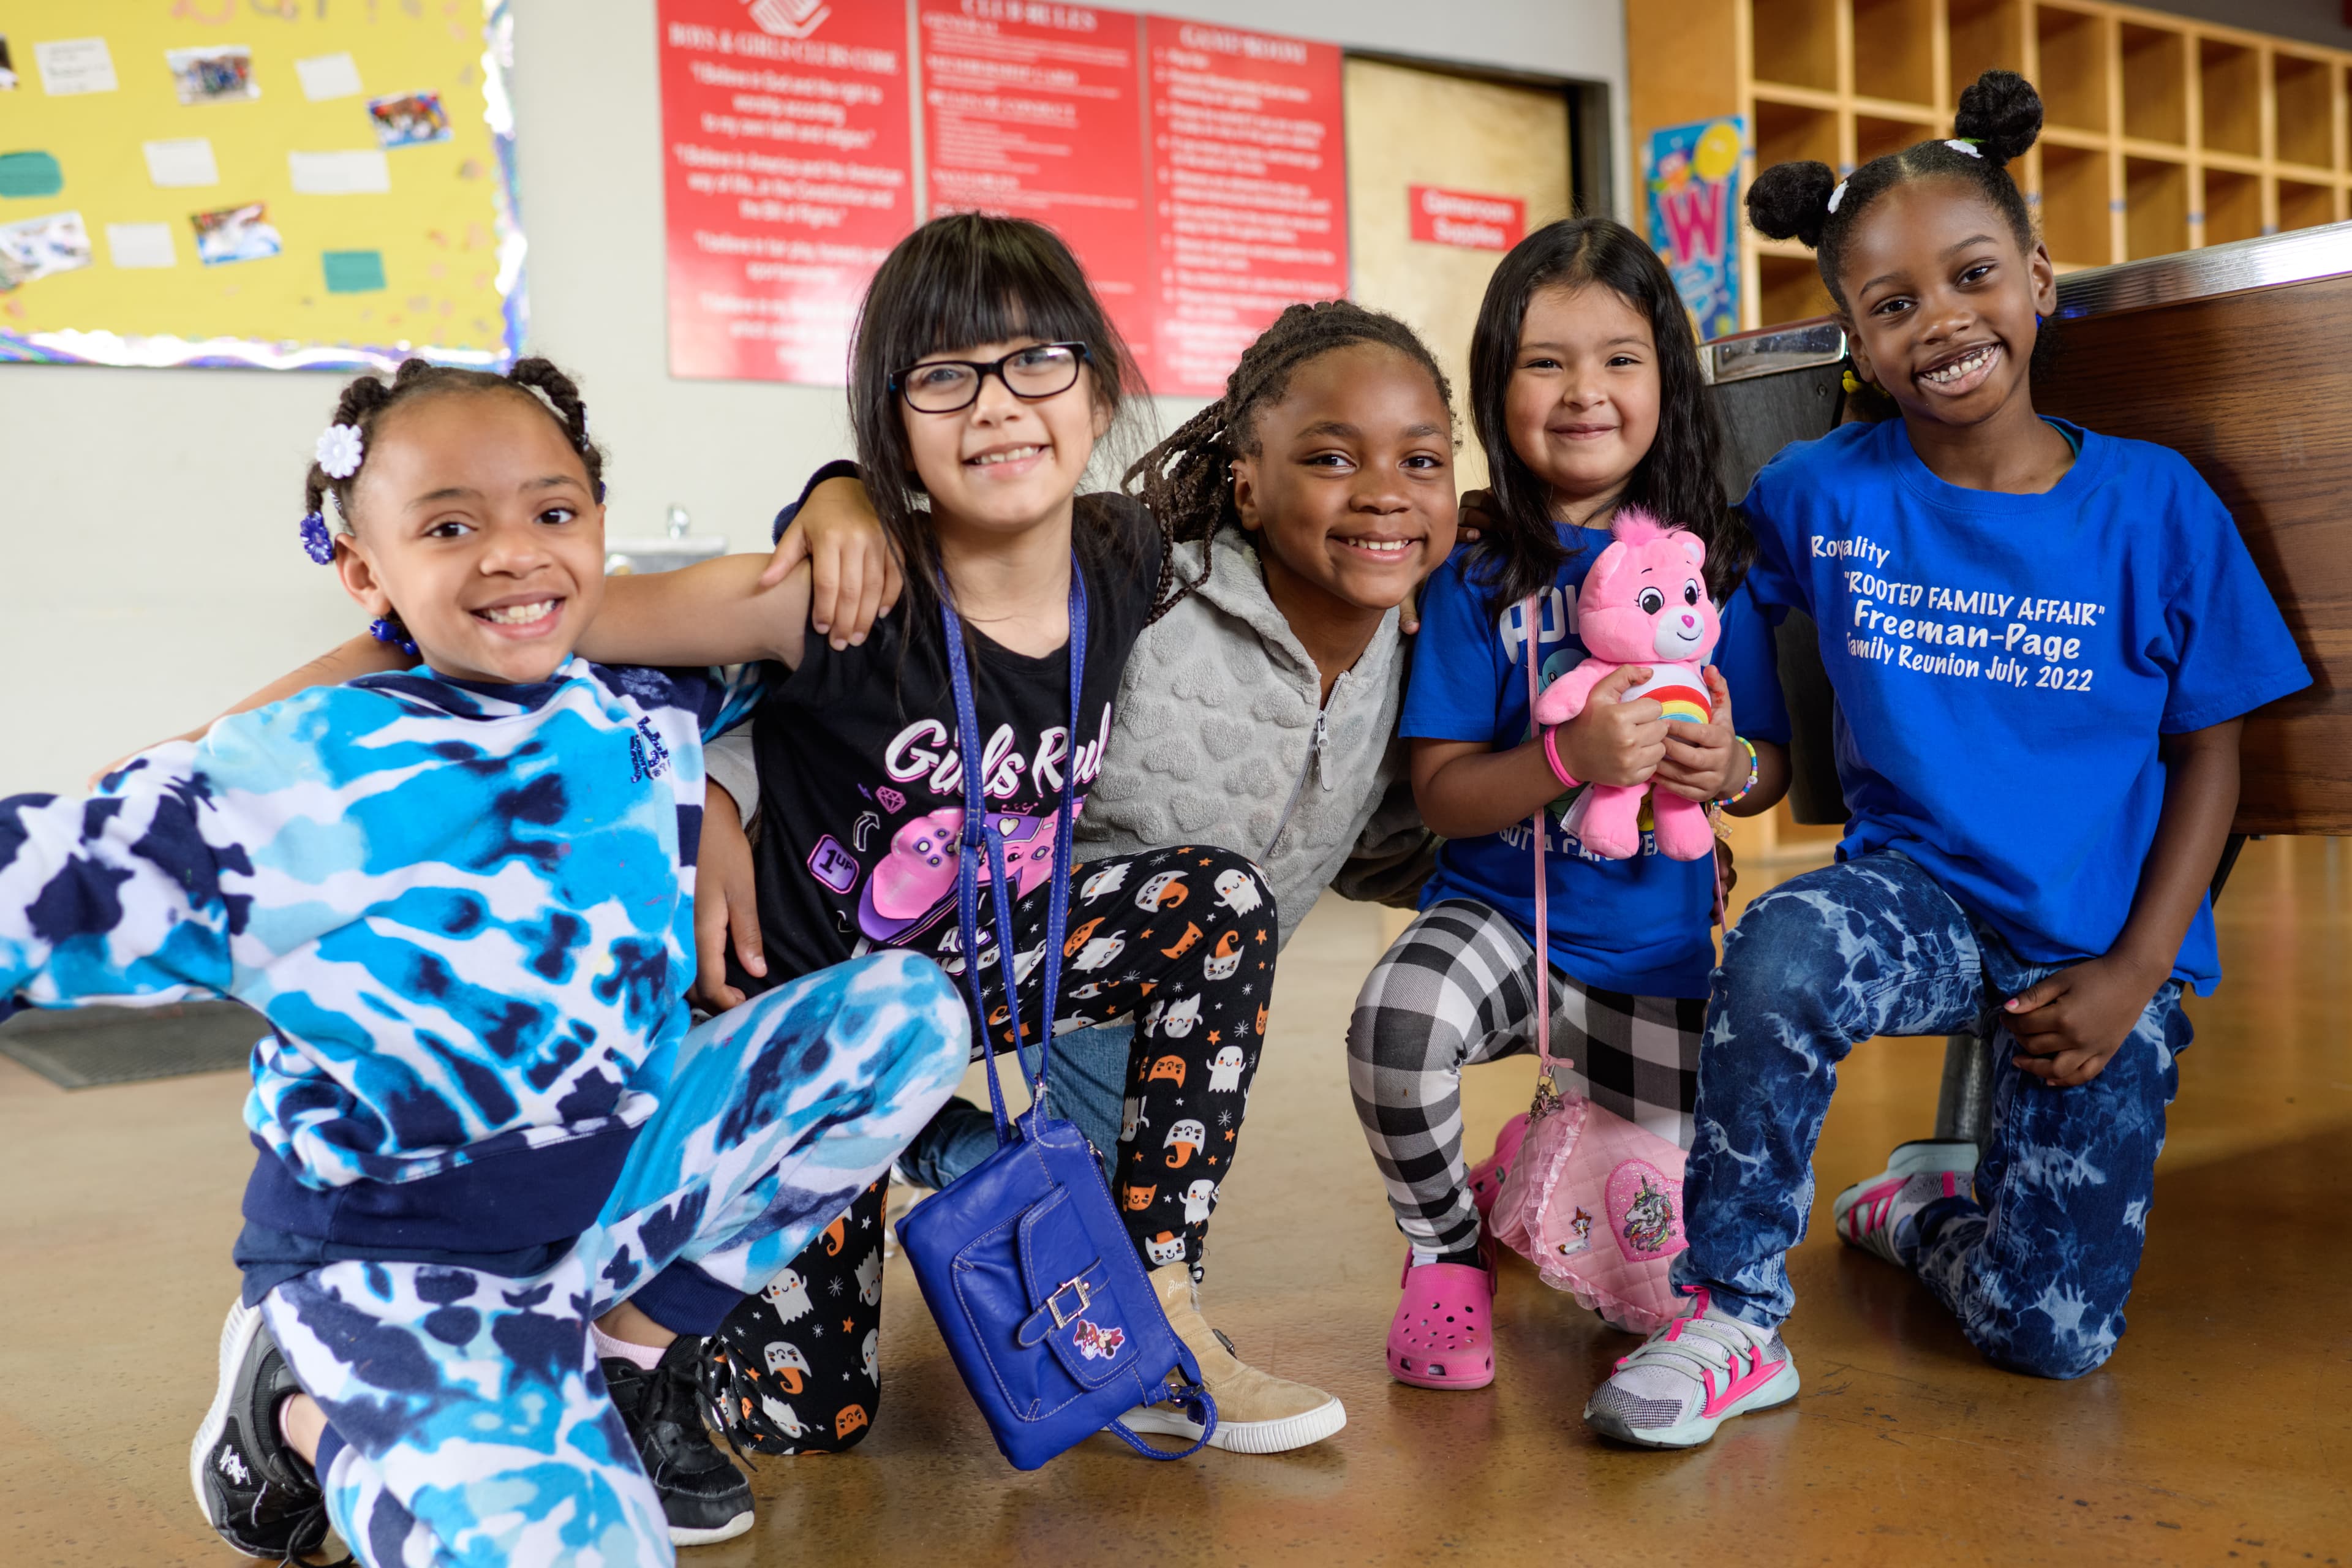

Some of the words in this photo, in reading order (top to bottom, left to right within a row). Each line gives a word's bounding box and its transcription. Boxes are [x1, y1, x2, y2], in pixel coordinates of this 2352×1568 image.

[1811, 535, 1890, 569] Royality
[1844, 570, 1923, 607] "ROOTED
[1928, 587, 2015, 618] FAMILY
[2016, 597, 2106, 627] AFFAIR"
[1853, 599, 2081, 663] Freeman-Page
[1898, 643, 1980, 679] Reunion
[1985, 655, 2029, 688] July,
[2034, 665, 2094, 692] 2022
